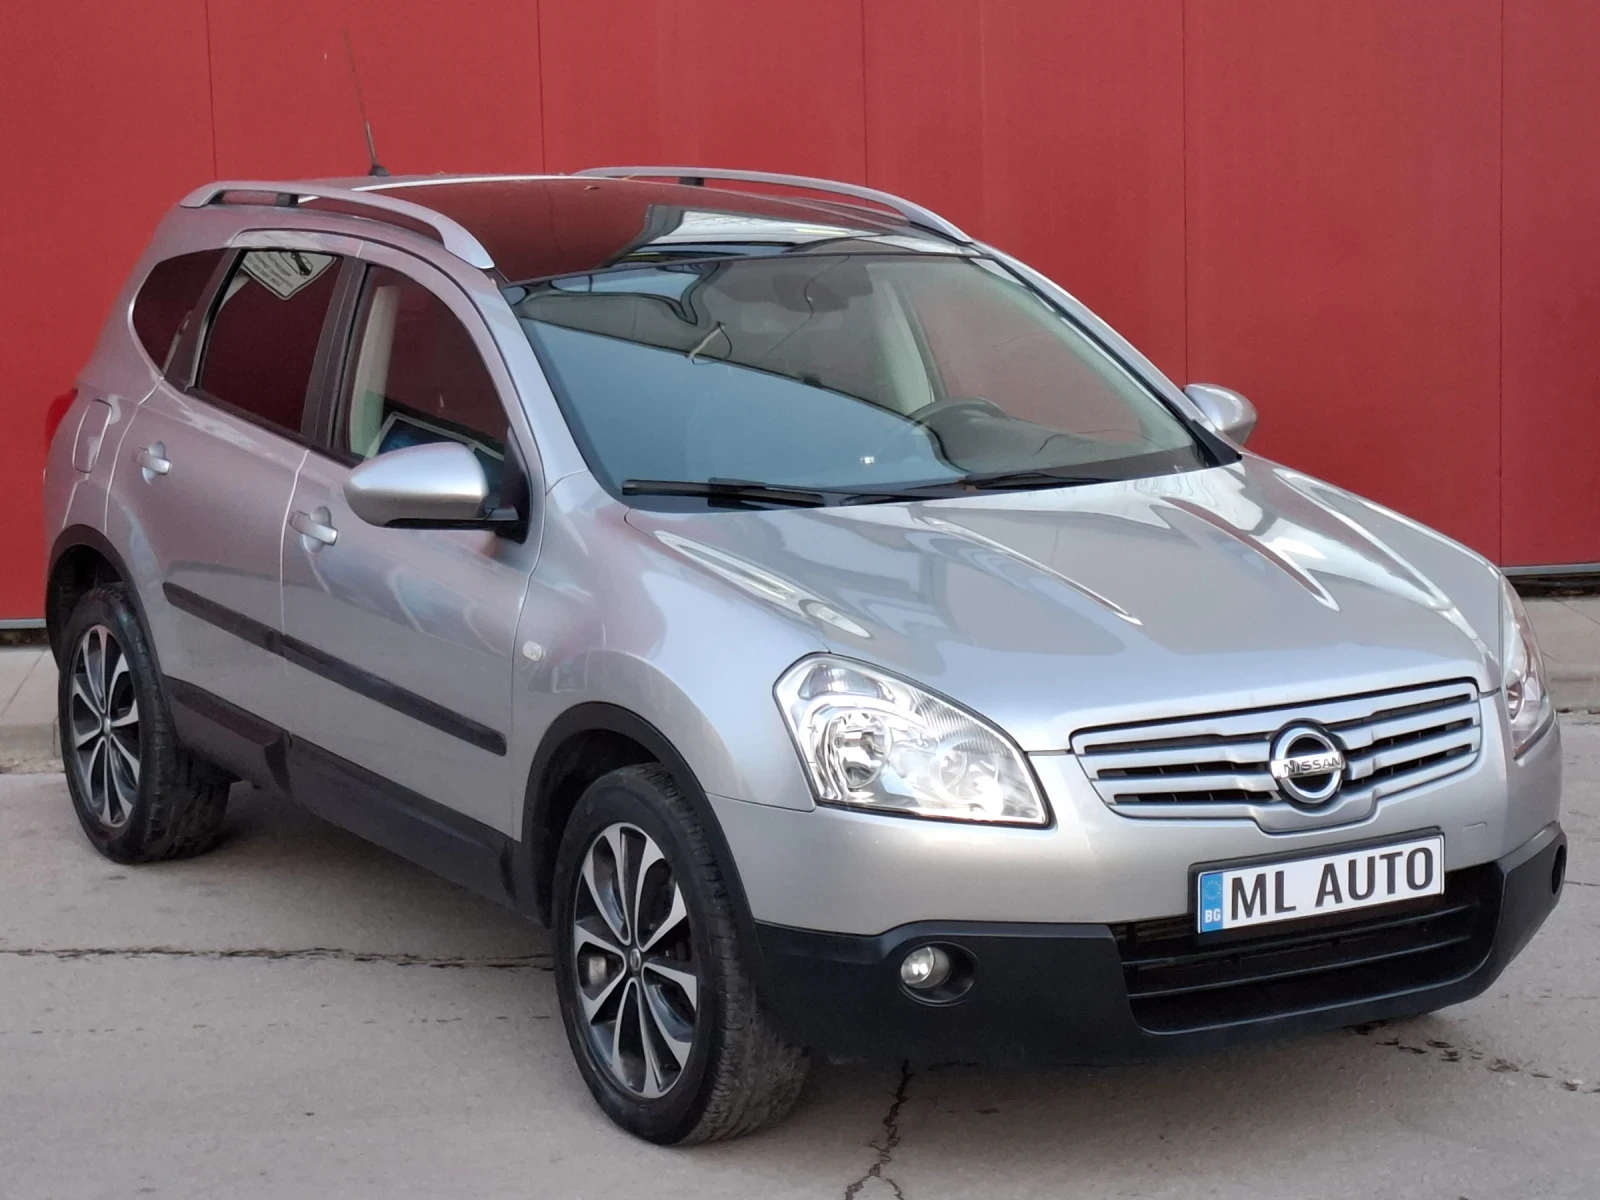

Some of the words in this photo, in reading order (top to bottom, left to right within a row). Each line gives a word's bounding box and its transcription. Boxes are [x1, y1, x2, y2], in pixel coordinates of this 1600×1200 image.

[1283, 756, 1341, 773] NISSAN
[1231, 870, 1296, 920] ML
[1314, 847, 1433, 907] AUTO
[1204, 908, 1221, 923] BG
